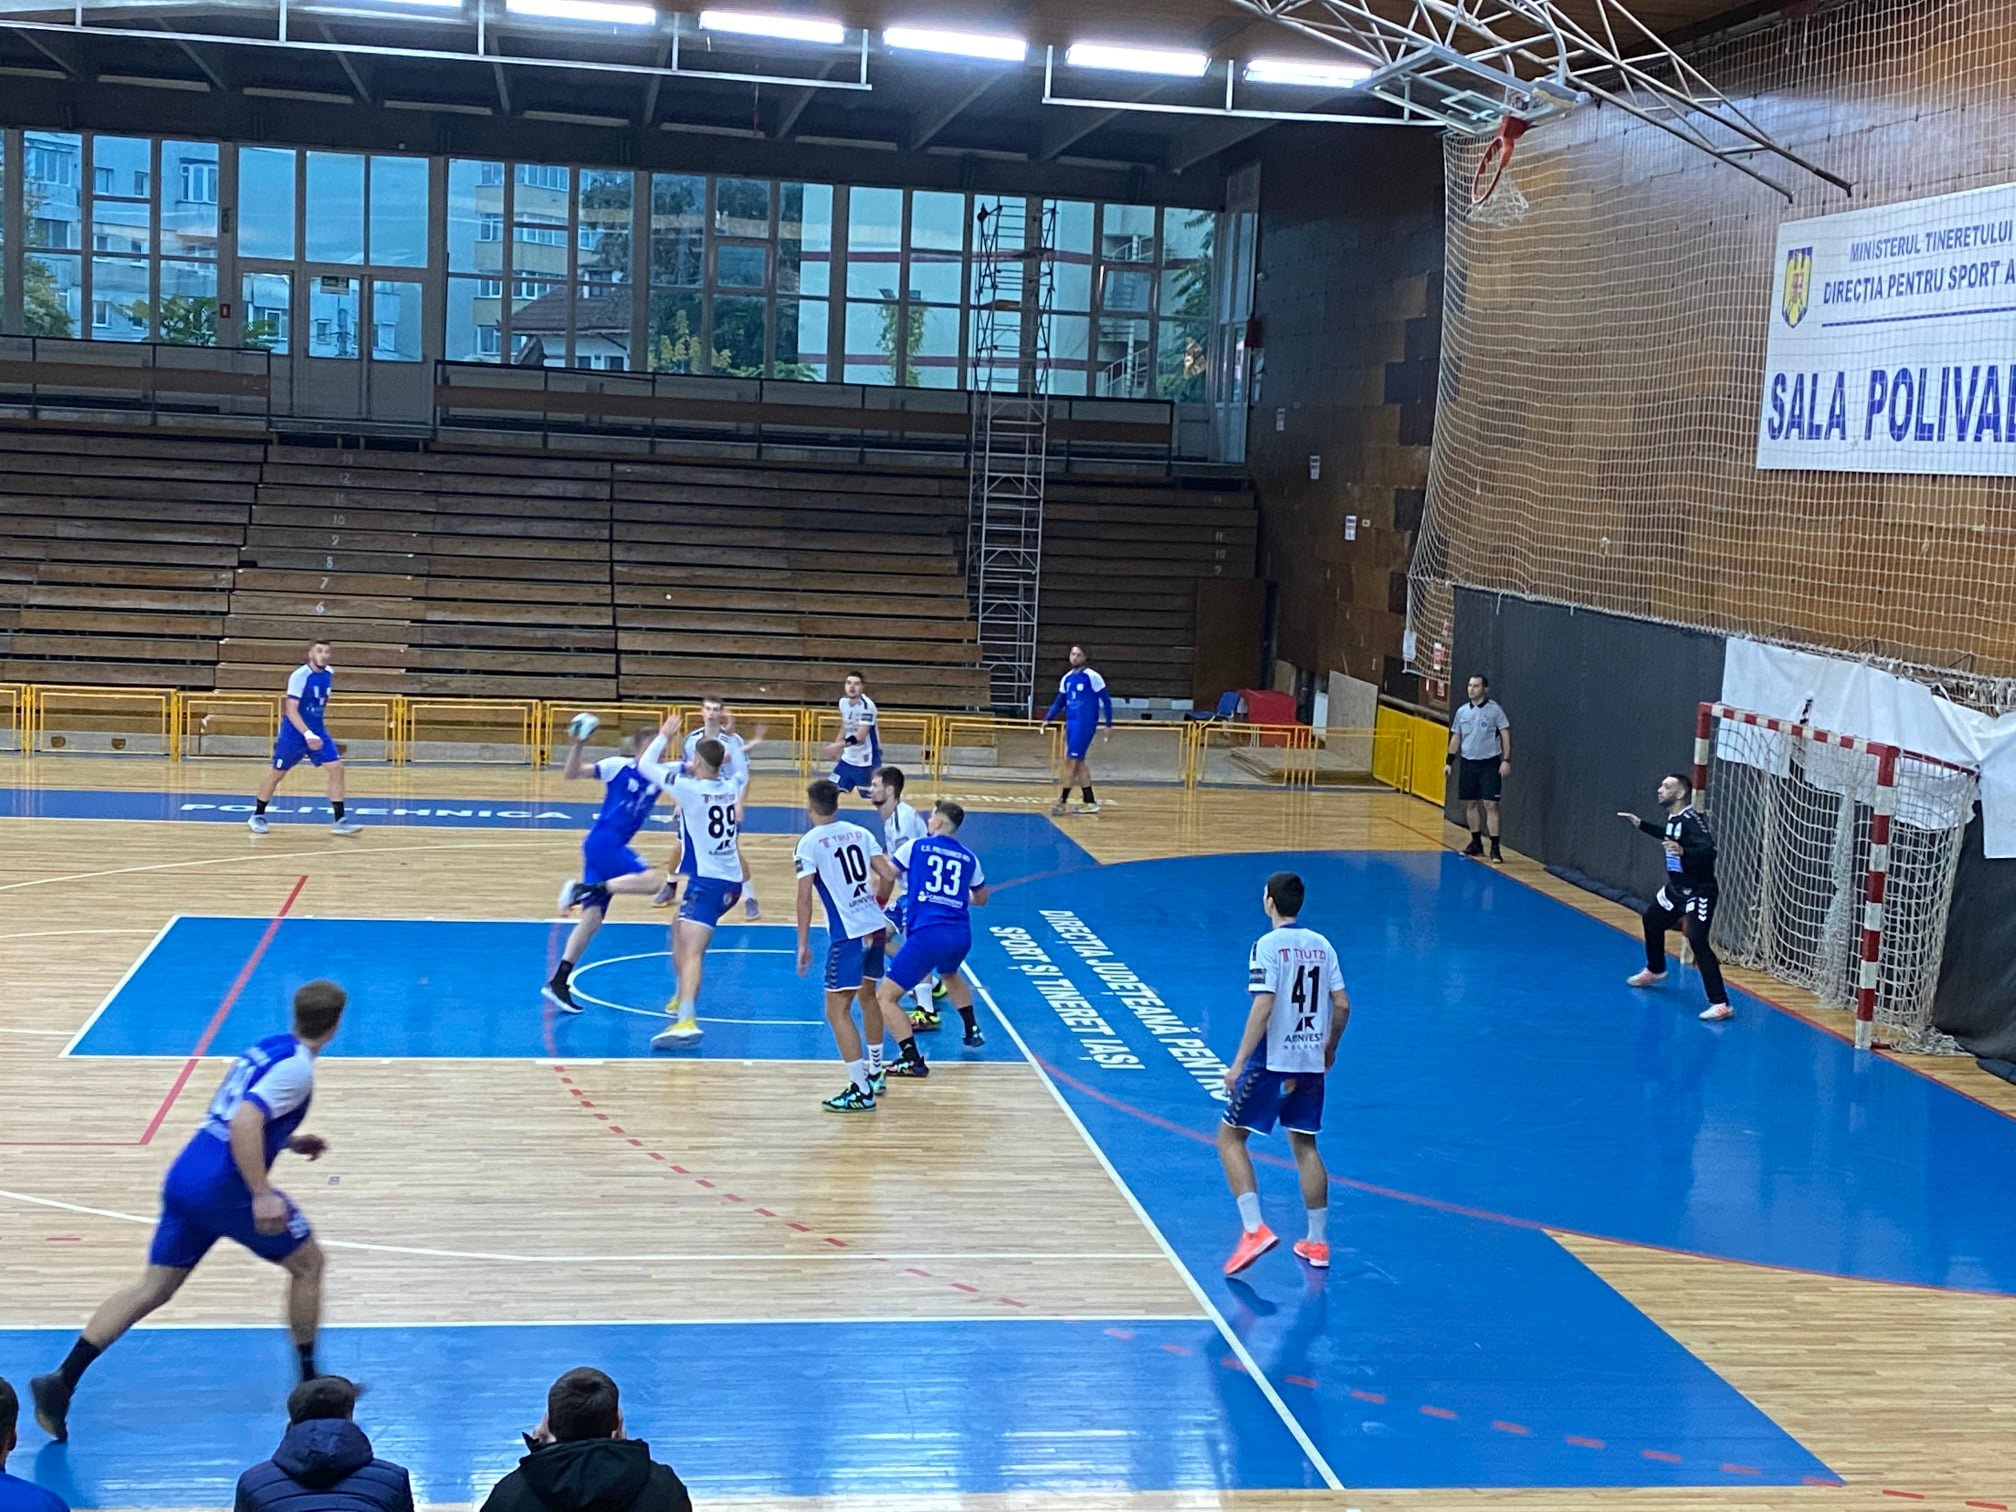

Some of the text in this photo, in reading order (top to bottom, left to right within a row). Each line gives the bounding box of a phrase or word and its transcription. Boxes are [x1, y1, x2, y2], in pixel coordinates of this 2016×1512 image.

[1850, 219, 2013, 262] MINISTERUL TINERETULUI
[1887, 267, 1944, 298] PENTRU
[1948, 260, 2000, 291] SPORT
[1767, 371, 1847, 441] SALA
[332, 514, 346, 526] 10
[331, 534, 340, 546] 9
[319, 577, 329, 590] 7
[315, 601, 325, 613] 6
[179, 803, 572, 820] POLITEHNICA
[708, 805, 736, 839] 89
[833, 844, 868, 885] 10
[925, 854, 962, 896] 33
[989, 926, 1052, 963] SPORT
[1032, 978, 1116, 1036] TINERET
[1291, 965, 1320, 1013] 41
